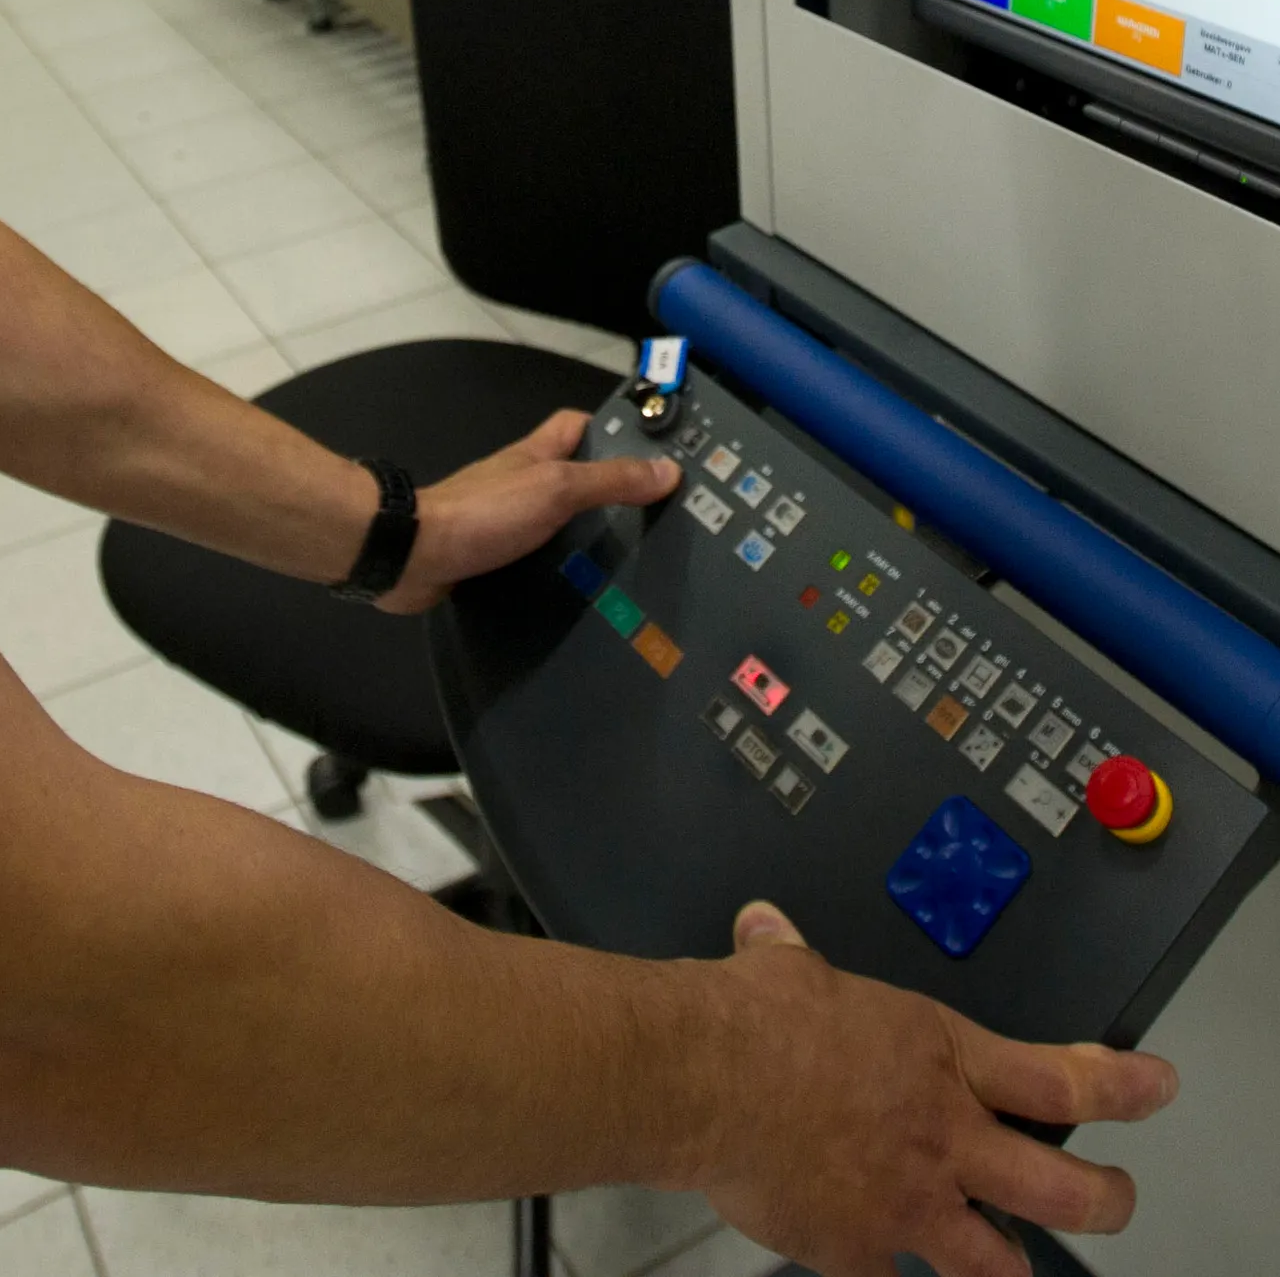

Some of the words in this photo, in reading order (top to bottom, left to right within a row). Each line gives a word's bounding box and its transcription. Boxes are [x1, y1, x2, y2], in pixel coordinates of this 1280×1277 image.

[947, 613, 959, 626] 2
[885, 626, 896, 636] 7
[980, 639, 992, 652] 3
[1016, 668, 1027, 679] 4
[1051, 695, 1063, 709] 5
[1089, 726, 1101, 740] 6
[742, 735, 771, 765] STOP
